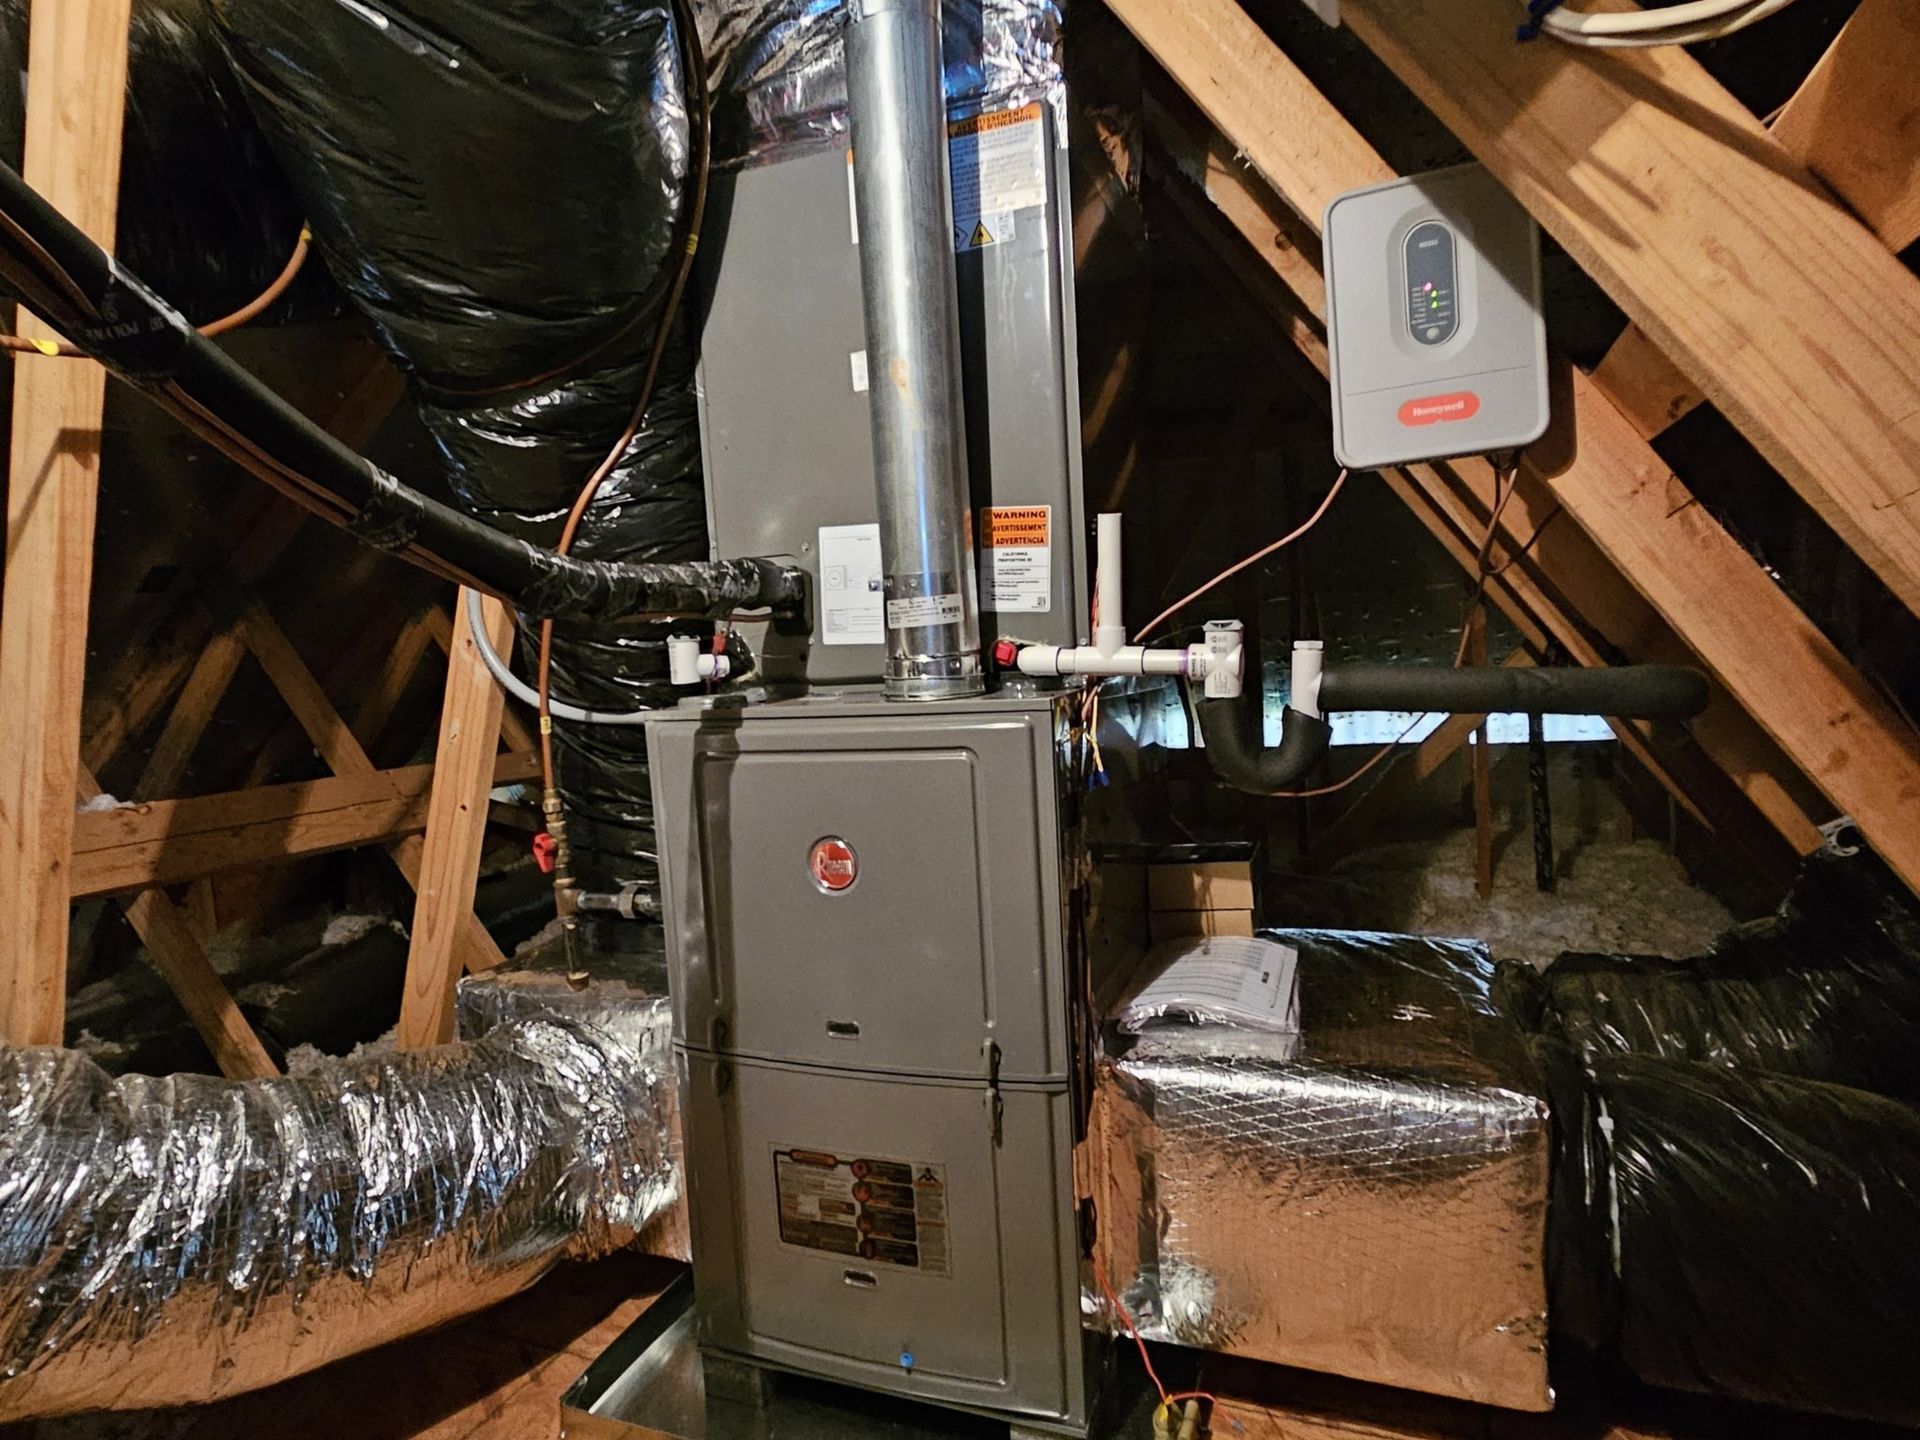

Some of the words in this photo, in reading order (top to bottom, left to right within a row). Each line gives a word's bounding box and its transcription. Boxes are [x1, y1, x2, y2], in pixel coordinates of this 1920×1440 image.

[993, 511, 1046, 519] WARNING
[992, 524, 1047, 532] AVERTISSEMENT
[995, 537, 1045, 545] ADVERTENCIA
